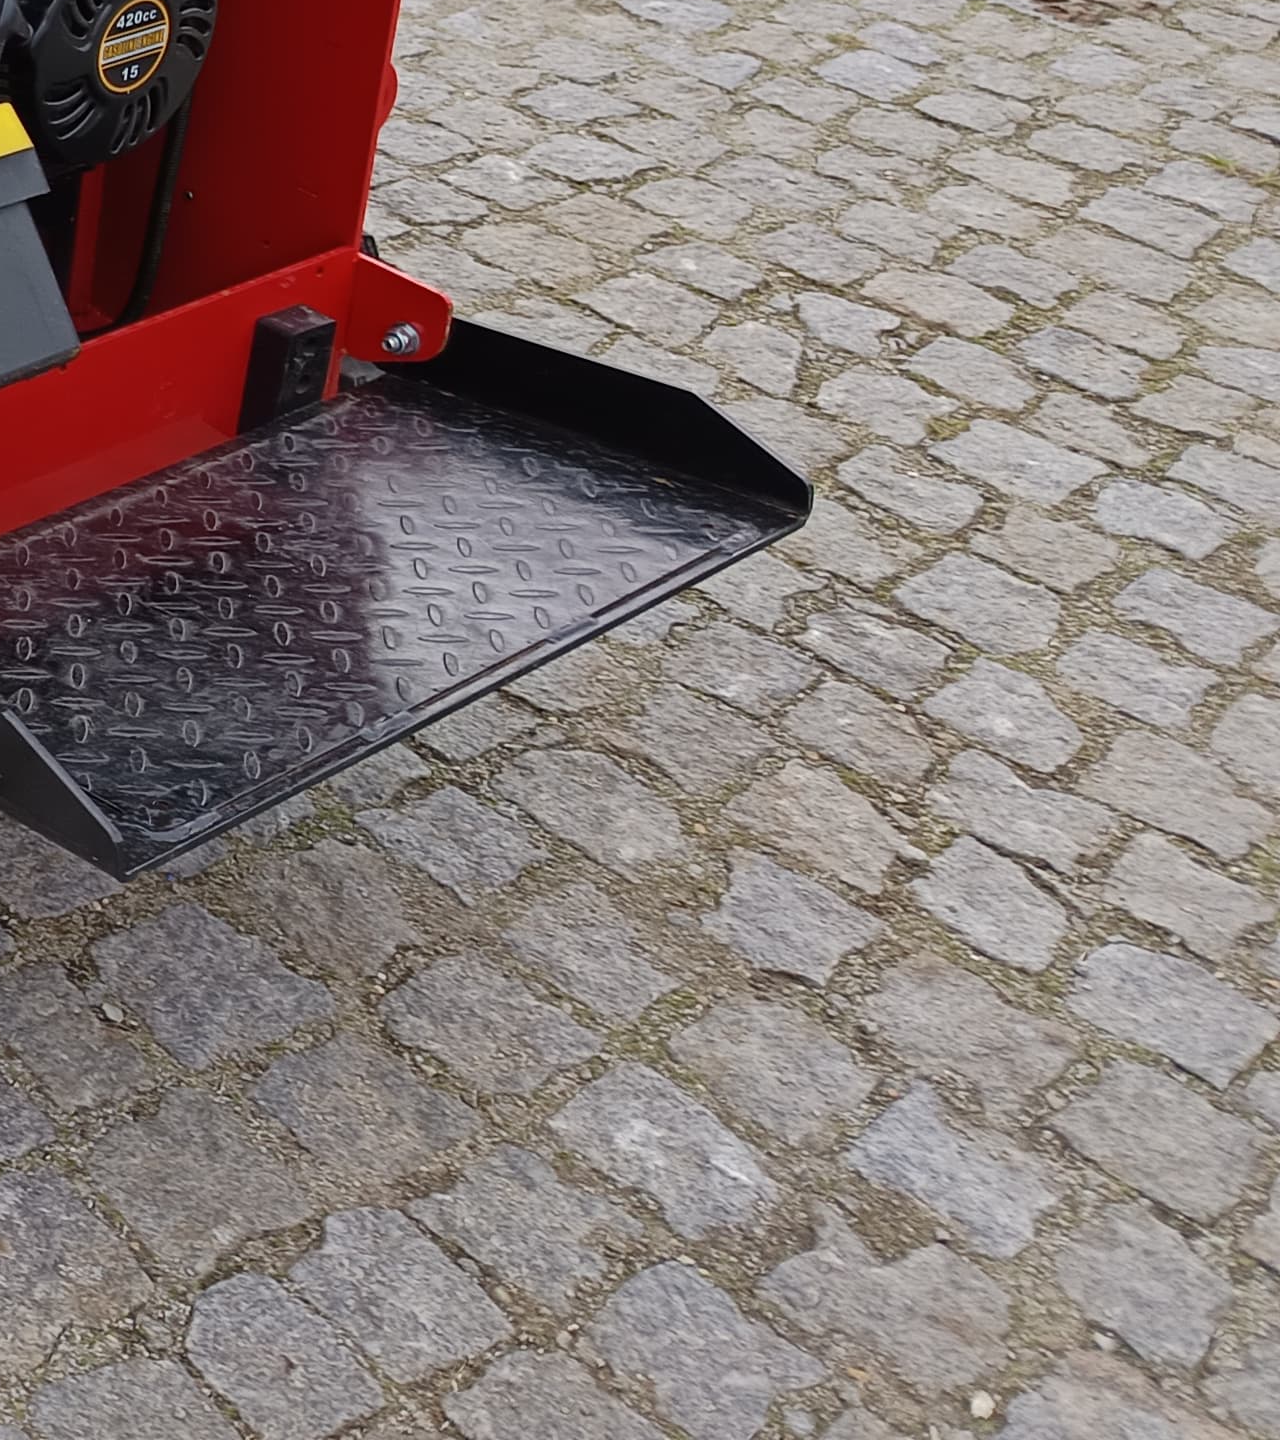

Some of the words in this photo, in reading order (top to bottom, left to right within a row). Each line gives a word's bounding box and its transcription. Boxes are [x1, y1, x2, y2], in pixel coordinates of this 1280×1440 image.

[116, 9, 157, 29] 420cc
[103, 37, 137, 59] GASOLINE
[138, 28, 165, 48] ENGINE
[121, 64, 139, 81] 15
